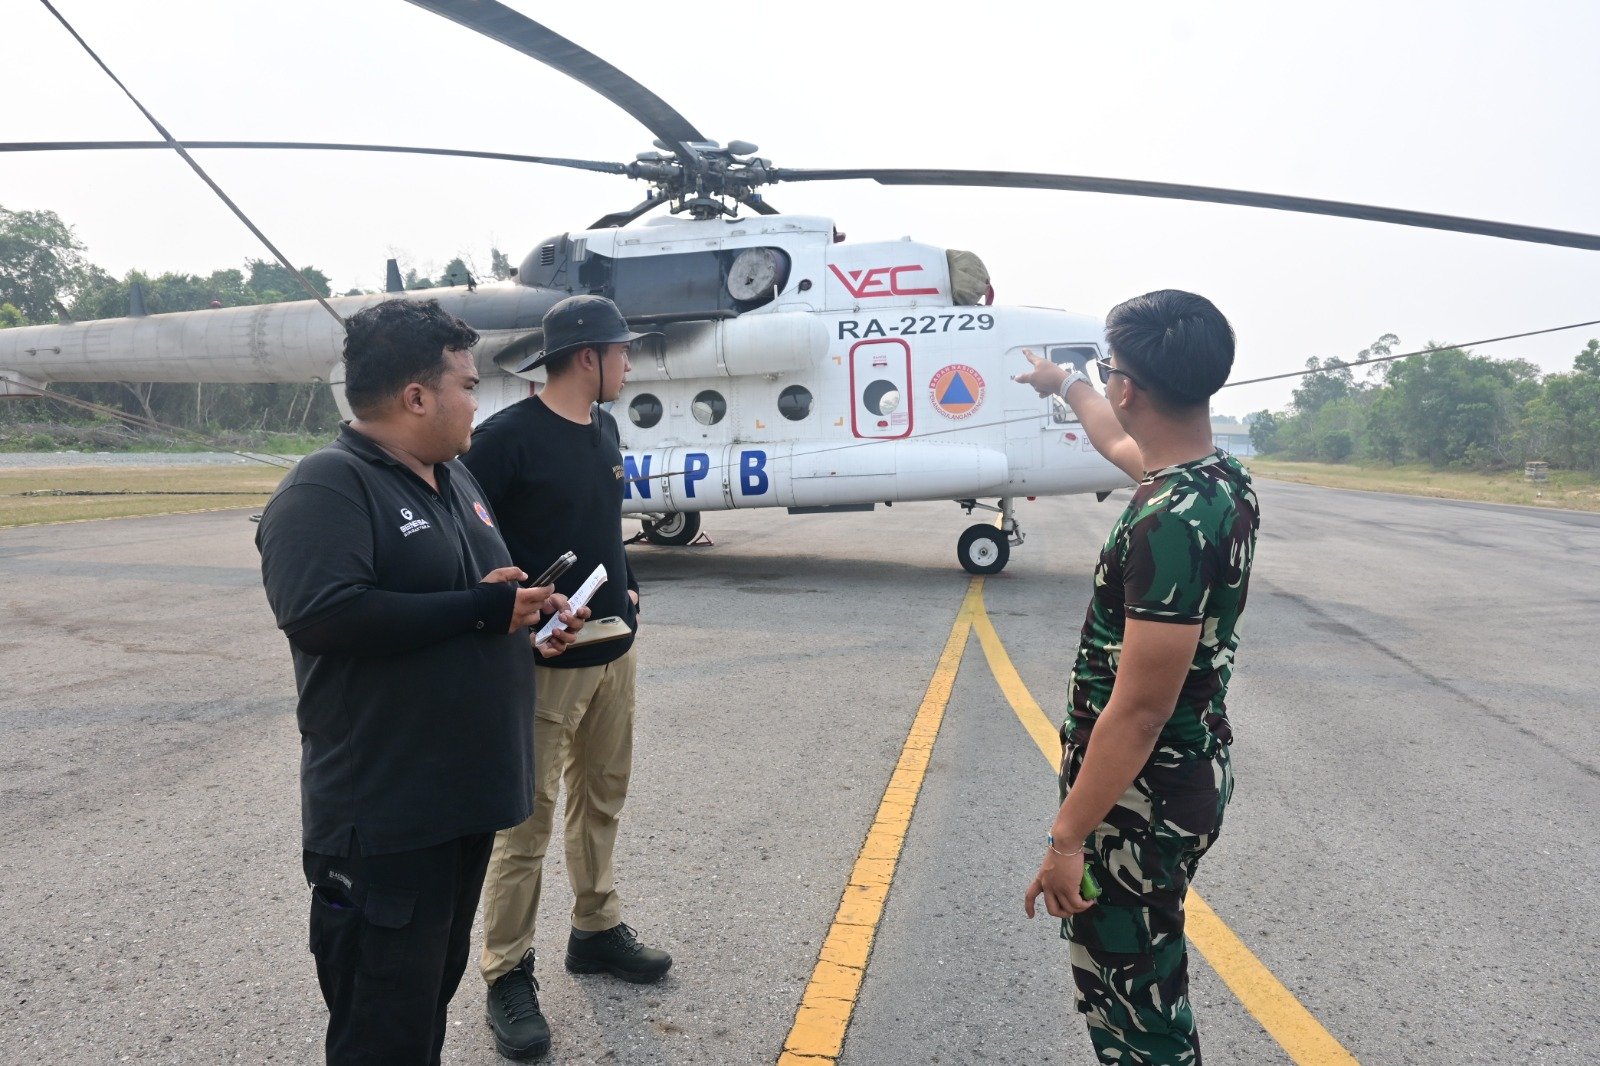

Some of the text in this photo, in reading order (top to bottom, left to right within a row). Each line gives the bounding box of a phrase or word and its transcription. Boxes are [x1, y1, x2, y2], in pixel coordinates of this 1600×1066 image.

[827, 264, 940, 299] VEC
[838, 313, 995, 340] RA-22729
[930, 364, 985, 387] BADAN NASIONAL
